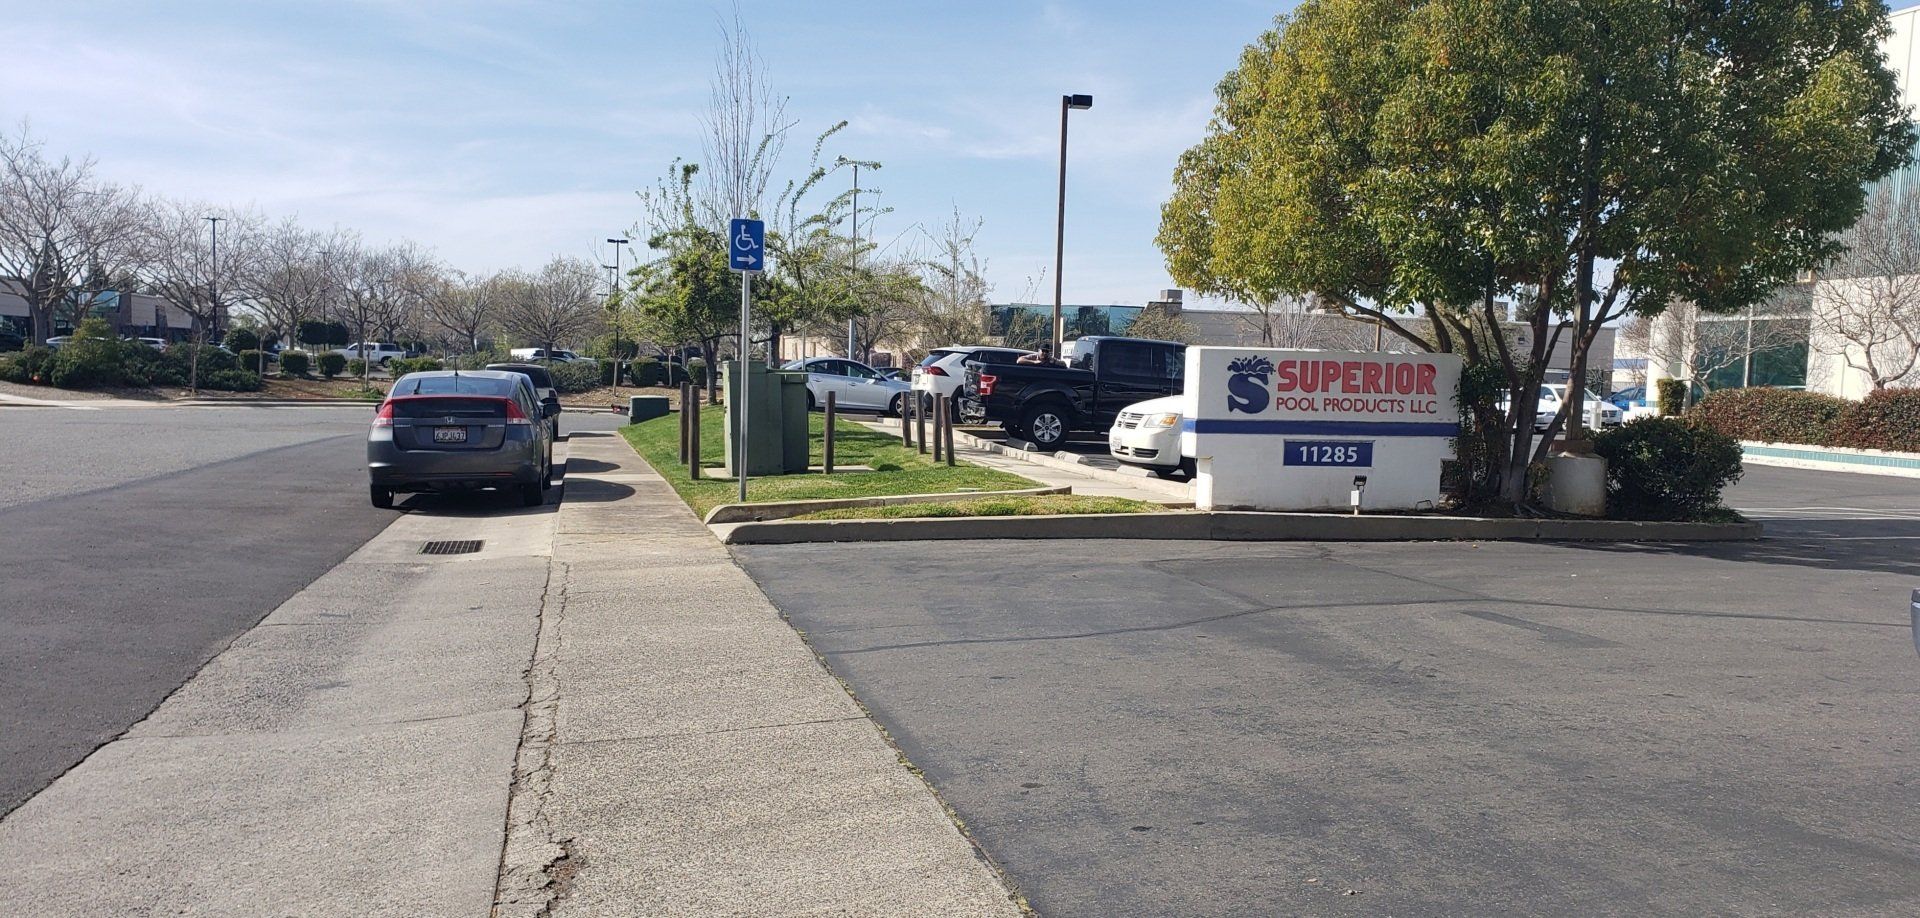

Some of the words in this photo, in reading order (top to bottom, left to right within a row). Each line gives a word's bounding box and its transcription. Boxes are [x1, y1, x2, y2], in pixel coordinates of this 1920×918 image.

[1277, 360, 1437, 395] SUPERIOR
[1276, 397, 1319, 412] POOL
[1323, 398, 1404, 413] PRODUCTS
[1410, 400, 1437, 414] LLC
[1300, 445, 1358, 463] 11285
